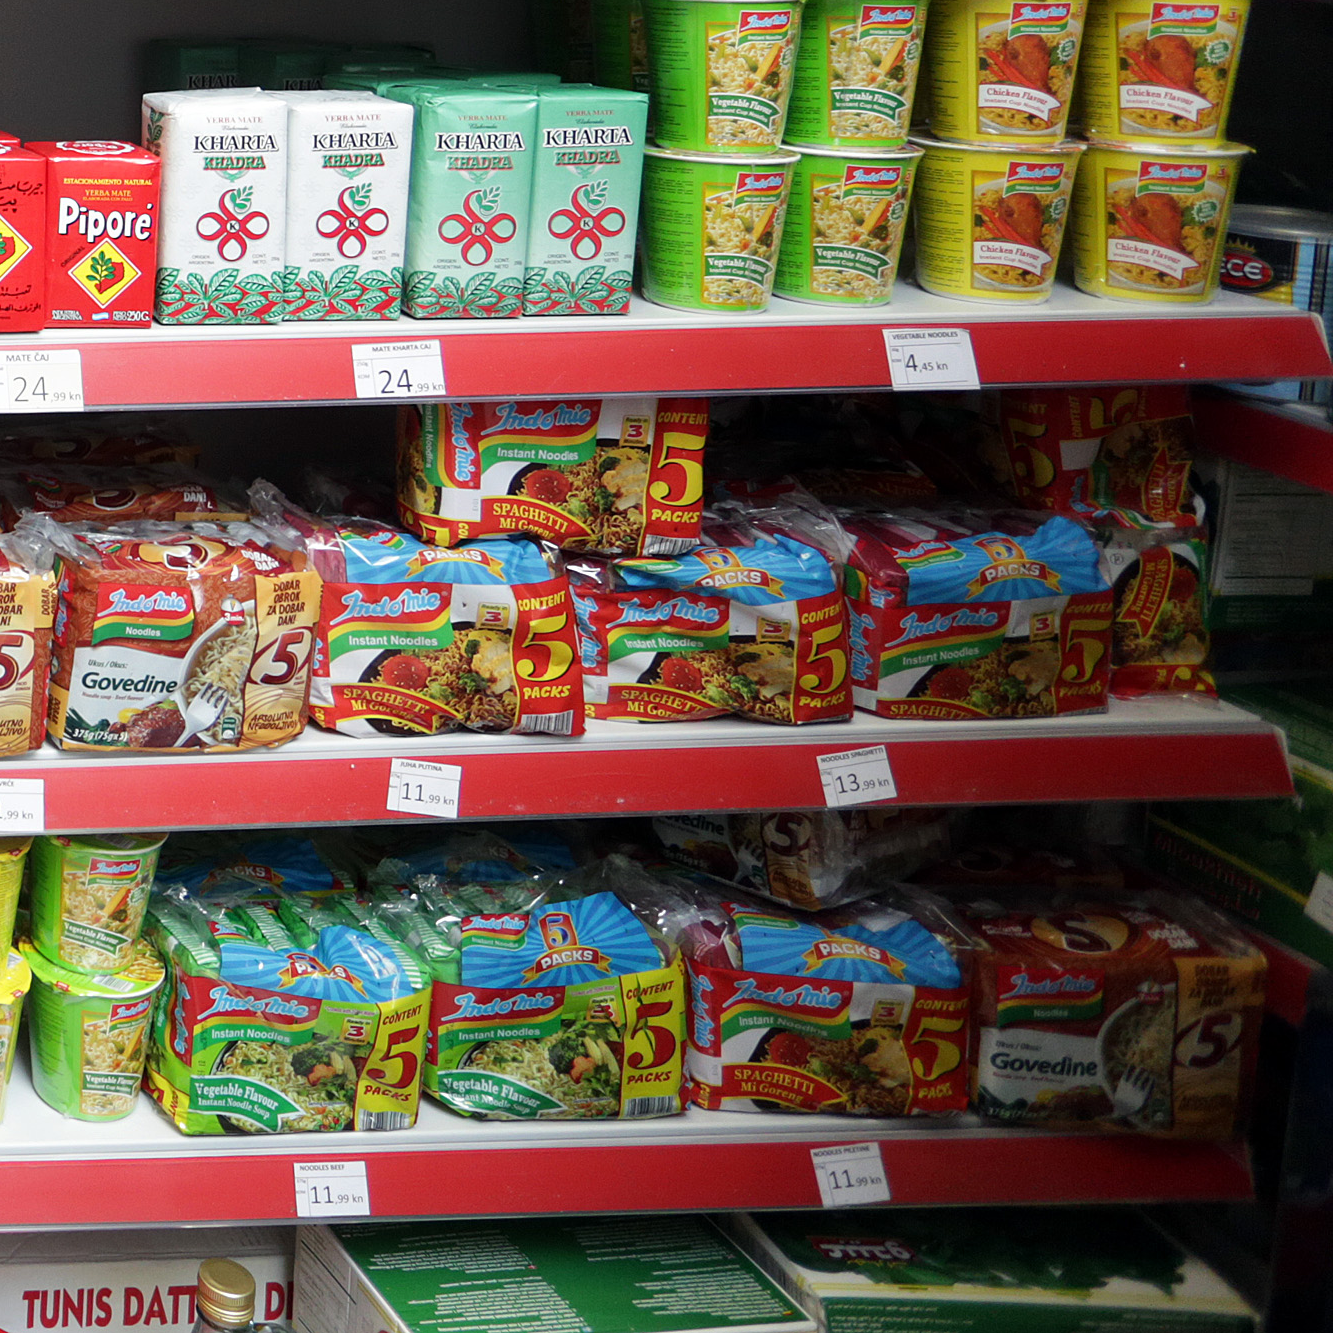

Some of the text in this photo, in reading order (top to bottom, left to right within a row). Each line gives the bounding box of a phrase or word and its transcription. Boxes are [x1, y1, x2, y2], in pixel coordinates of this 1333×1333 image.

[193, 136, 278, 152] KHARTA
[203, 155, 265, 170] KHADRA
[892, 331, 958, 341] VEGETABLE NOODLES
[6, 352, 50, 363] MATE ČAJ
[497, 447, 579, 462] Instant Noodles
[493, 502, 568, 534] SPAGHETTI
[518, 591, 566, 610] CONTENT
[516, 613, 574, 682] 5
[523, 685, 570, 699] PACKS
[821, 752, 849, 764] NOODLES
[627, 1071, 672, 1085] PACKS
[195, 1082, 279, 1110] Vegetable Flavour
[23, 1285, 200, 1329] TUNIS DATT
